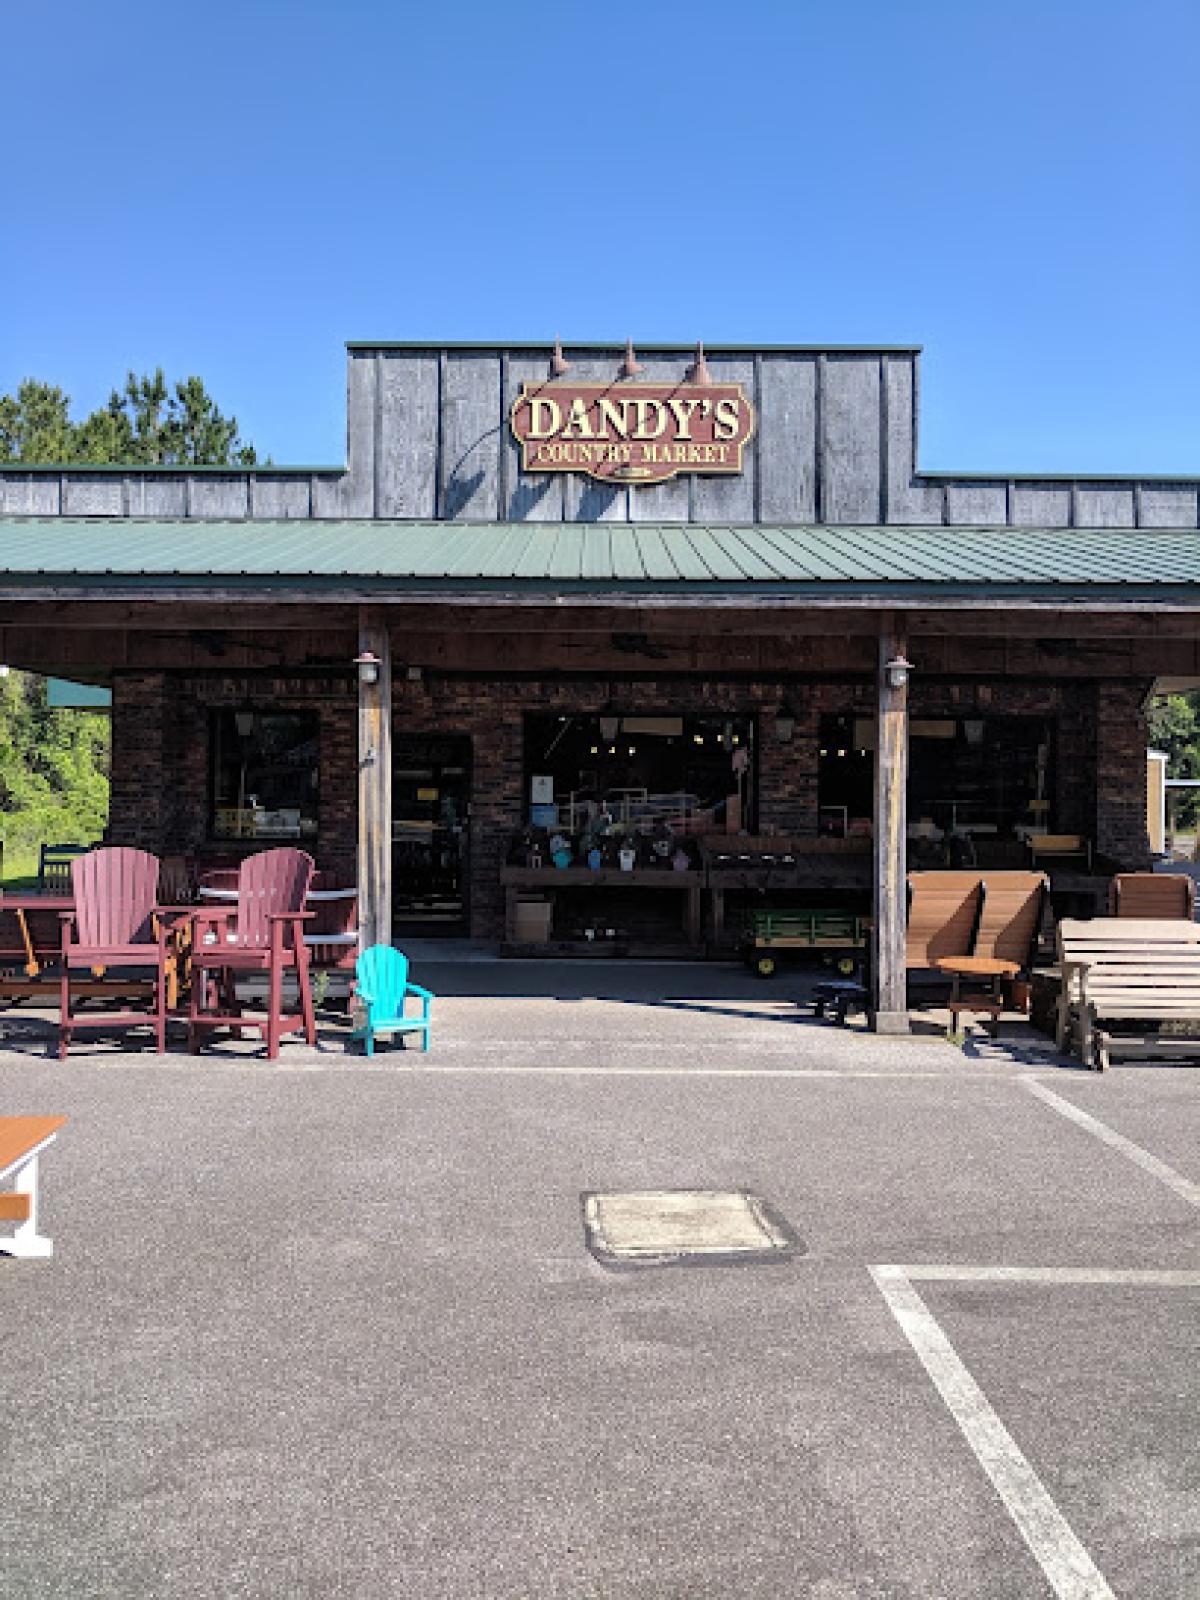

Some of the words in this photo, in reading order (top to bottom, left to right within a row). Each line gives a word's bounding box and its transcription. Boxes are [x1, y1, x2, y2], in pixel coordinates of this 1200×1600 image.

[526, 398, 739, 439] DANDY'S
[538, 443, 633, 463] COUNTRY
[641, 443, 729, 463] MARKET
